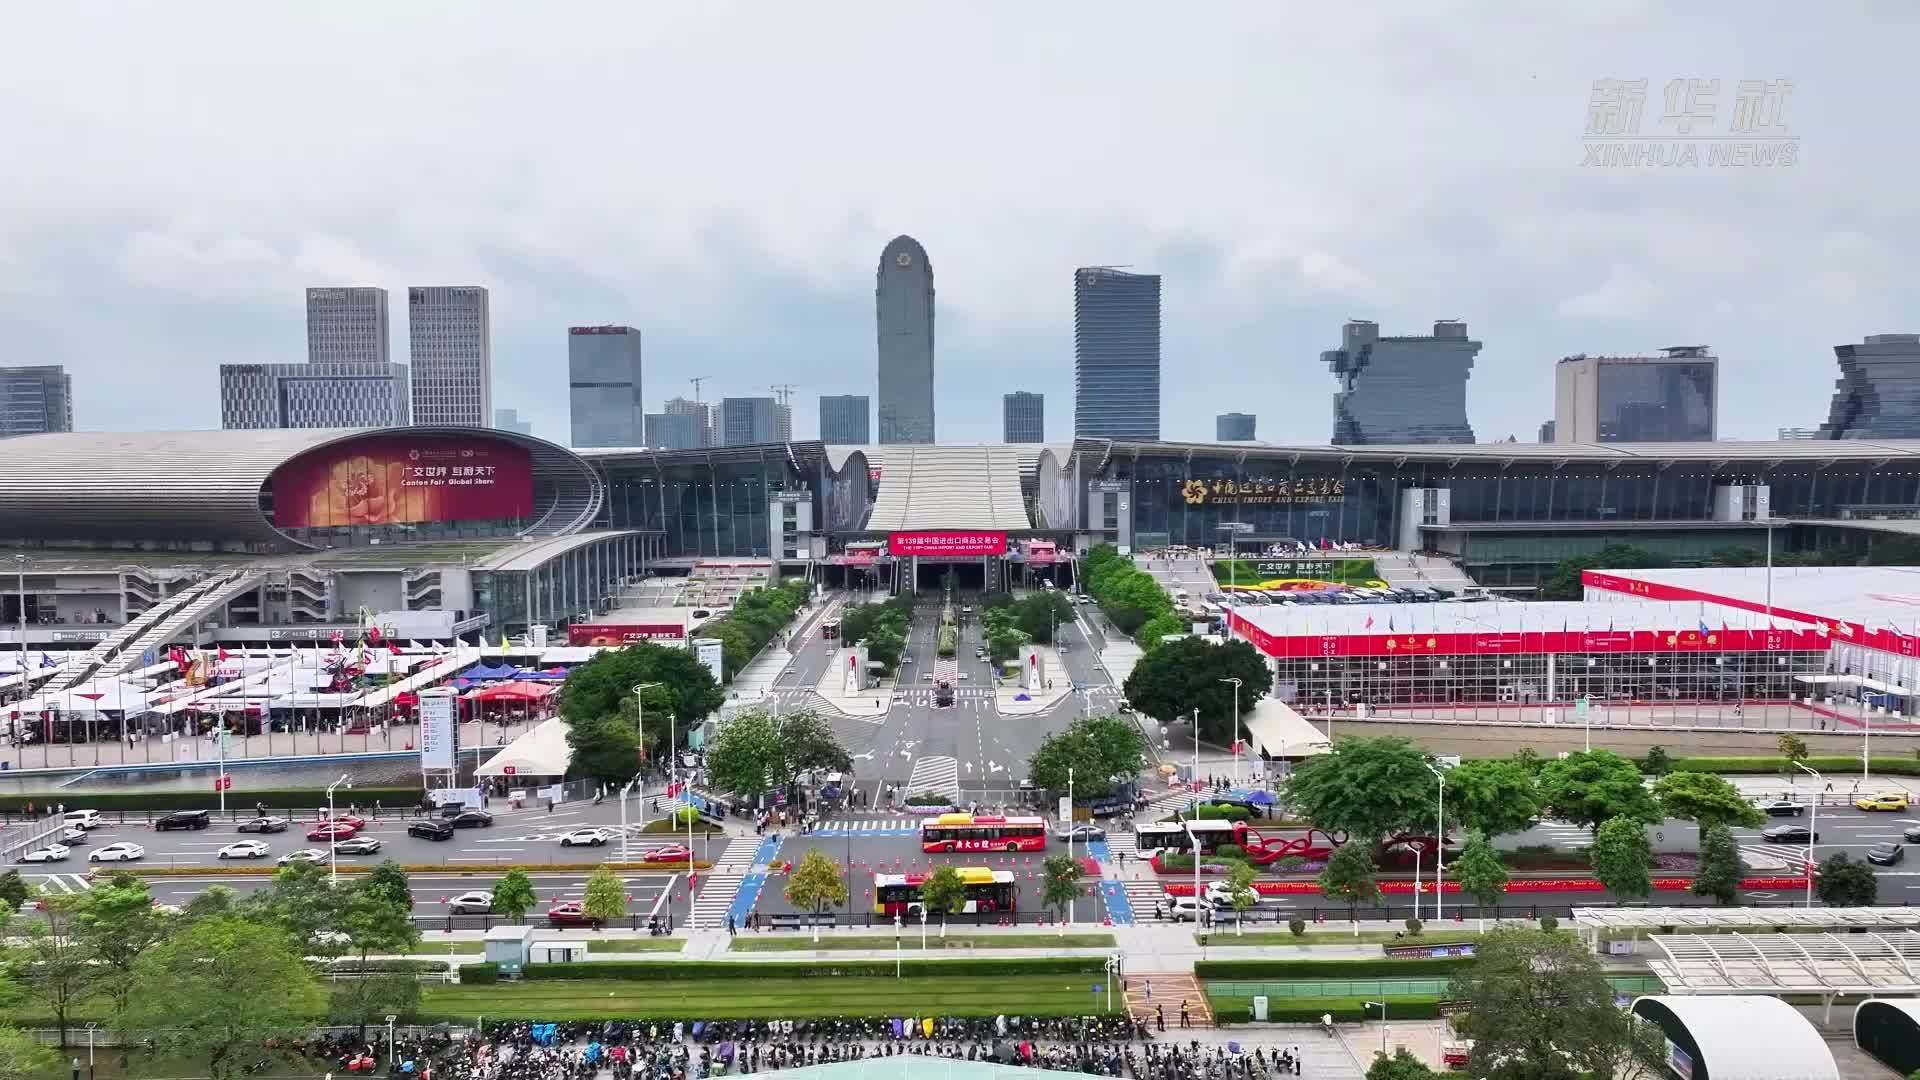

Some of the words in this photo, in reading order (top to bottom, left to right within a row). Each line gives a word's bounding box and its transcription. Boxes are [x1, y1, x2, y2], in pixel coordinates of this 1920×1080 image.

[401, 466, 447, 477] 广交世界
[1212, 496, 1236, 504] CHINA
[1243, 496, 1272, 504] IMPORT
[1120, 502, 1128, 510] 5
[1258, 562, 1291, 570] 广交世界
